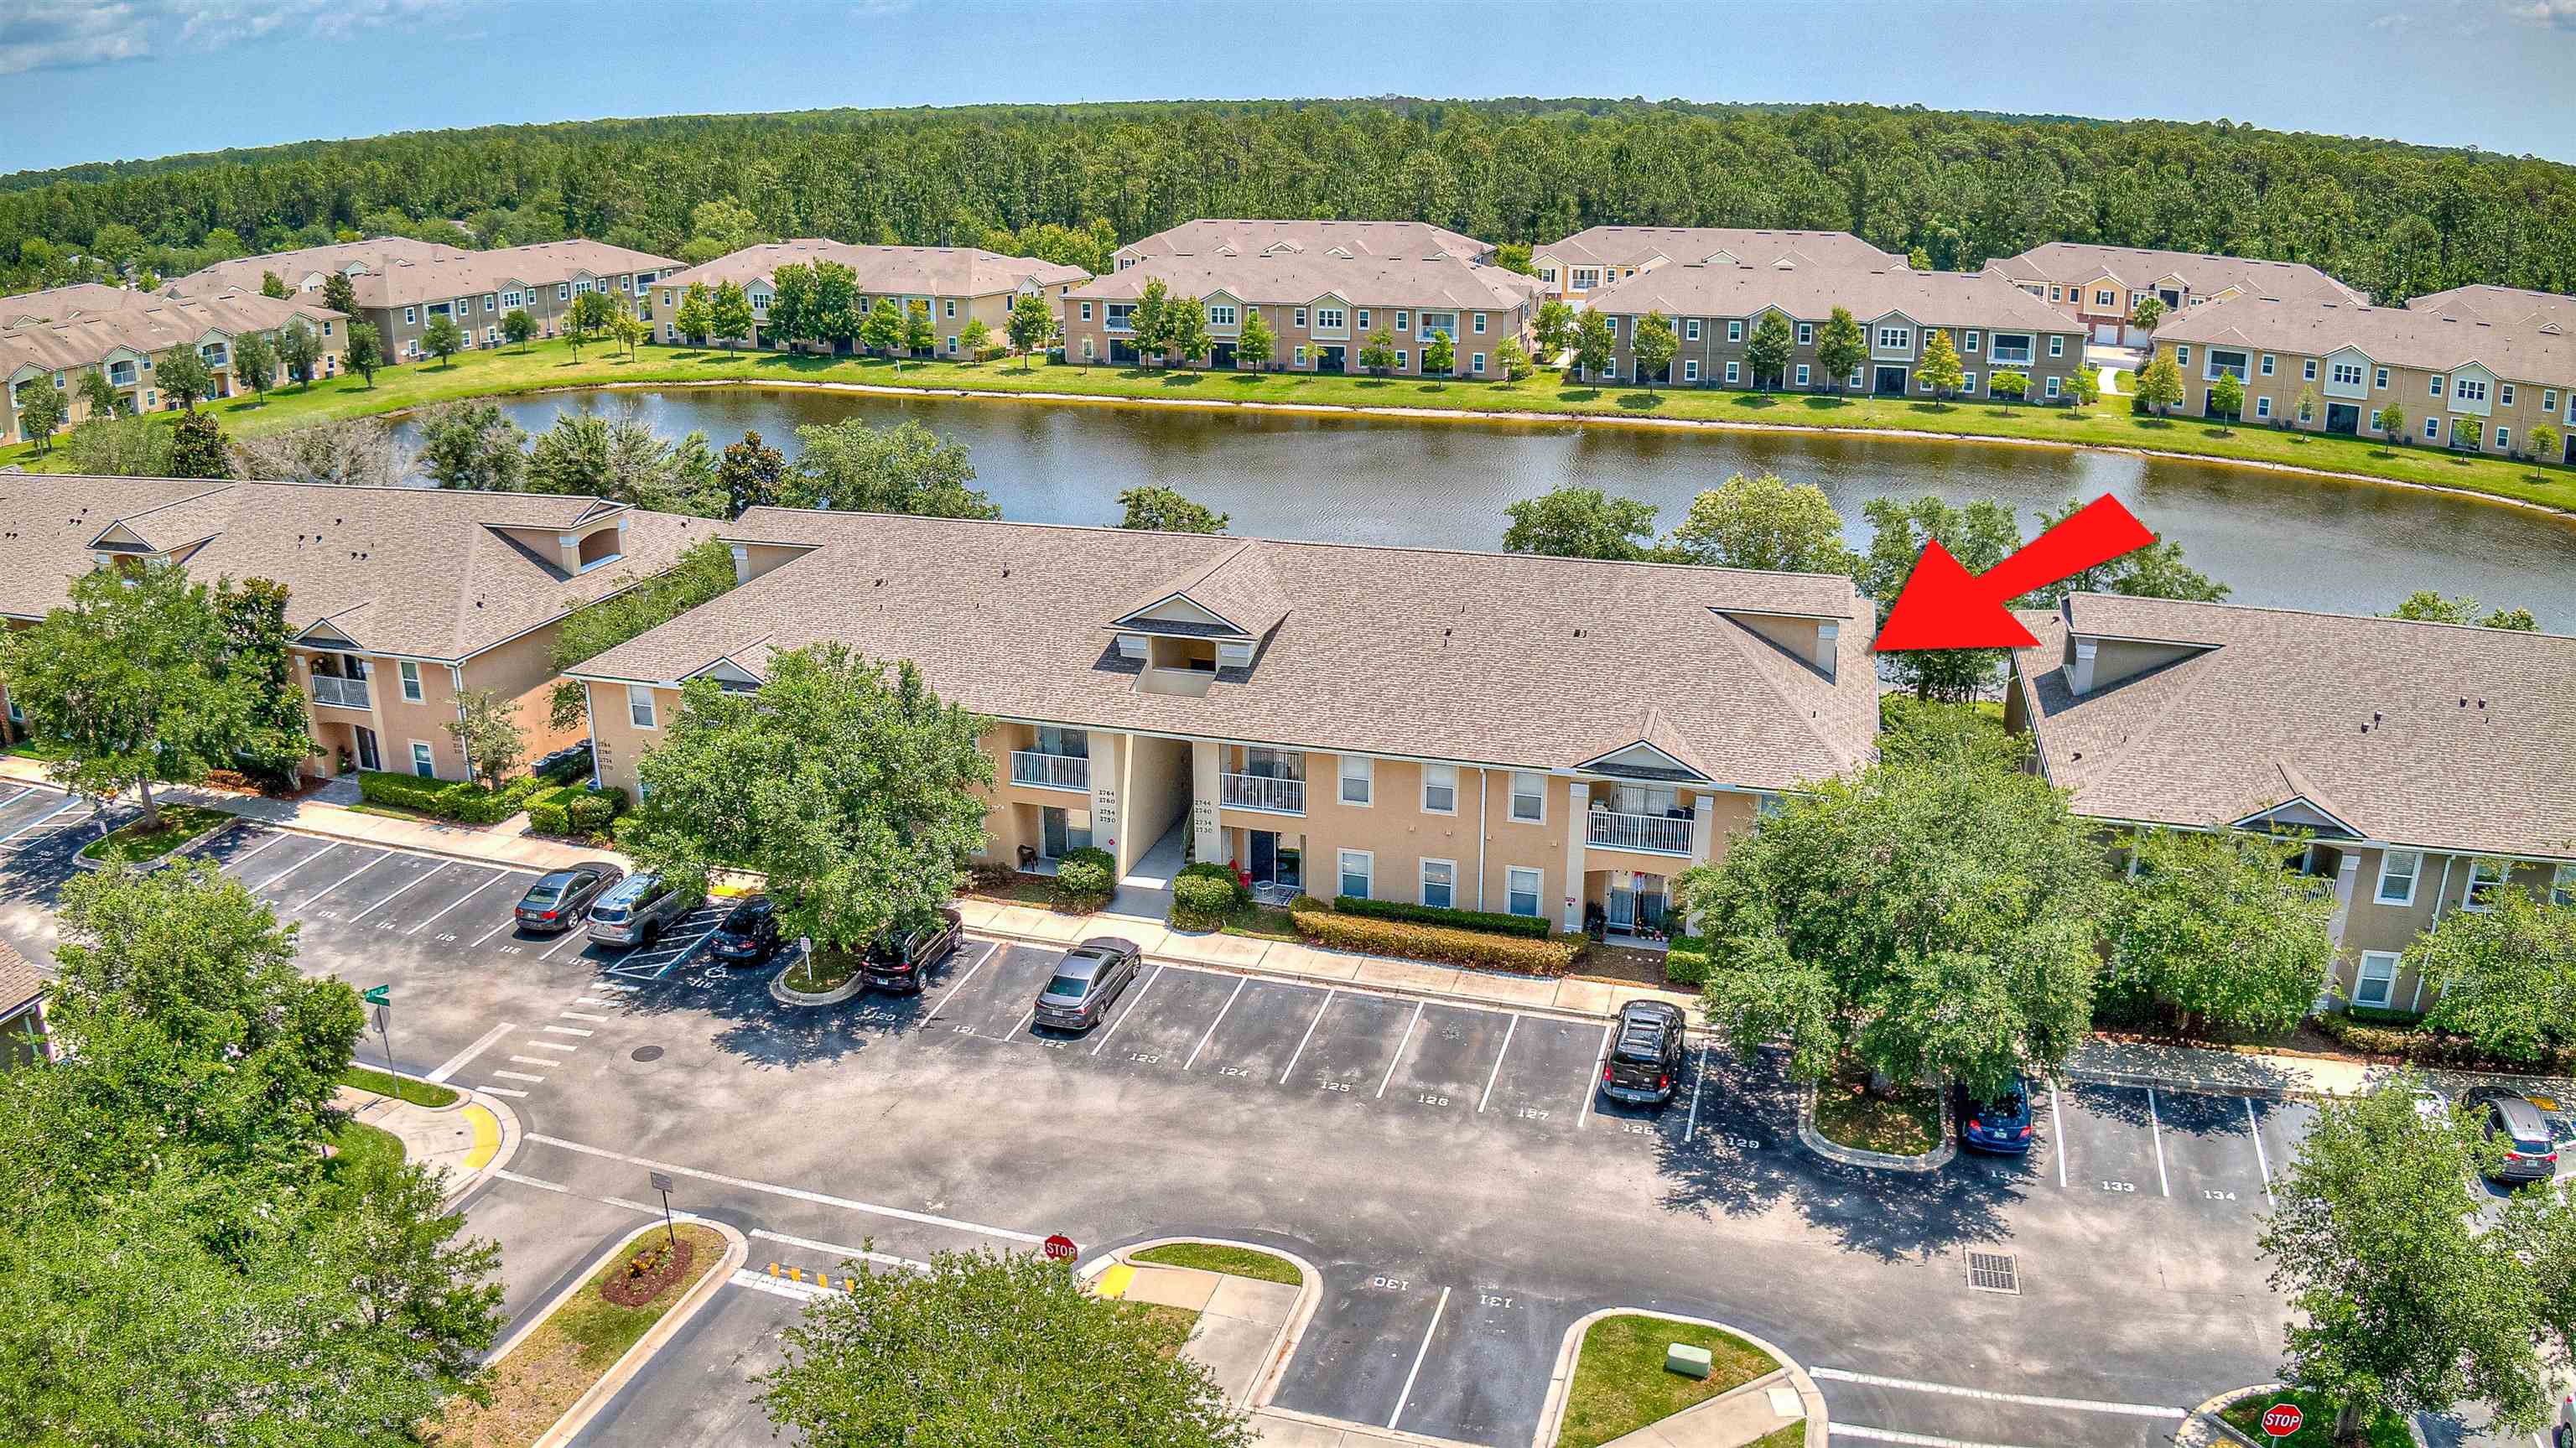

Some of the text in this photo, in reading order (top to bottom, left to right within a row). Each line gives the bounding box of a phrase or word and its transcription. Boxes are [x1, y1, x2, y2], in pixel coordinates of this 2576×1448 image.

[499, 945, 522, 954] 116
[568, 958, 590, 967] 117
[1038, 1038, 1067, 1048] 122
[1130, 1053, 1160, 1064] 123
[1218, 1067, 1249, 1077] 124
[1321, 1081, 1352, 1092] 125
[1417, 1093, 1449, 1107] 126
[1516, 1107, 1550, 1120] 127
[1623, 1124, 1654, 1135] 128
[1727, 1137, 1759, 1149] 129
[2102, 1181, 2135, 1192] 133
[2204, 1190, 2236, 1201] 134
[1046, 1243, 1076, 1258] STOP
[1374, 1277, 1409, 1291] 130
[1480, 1294, 1513, 1309] 131
[2265, 1414, 2299, 1427] STOP
